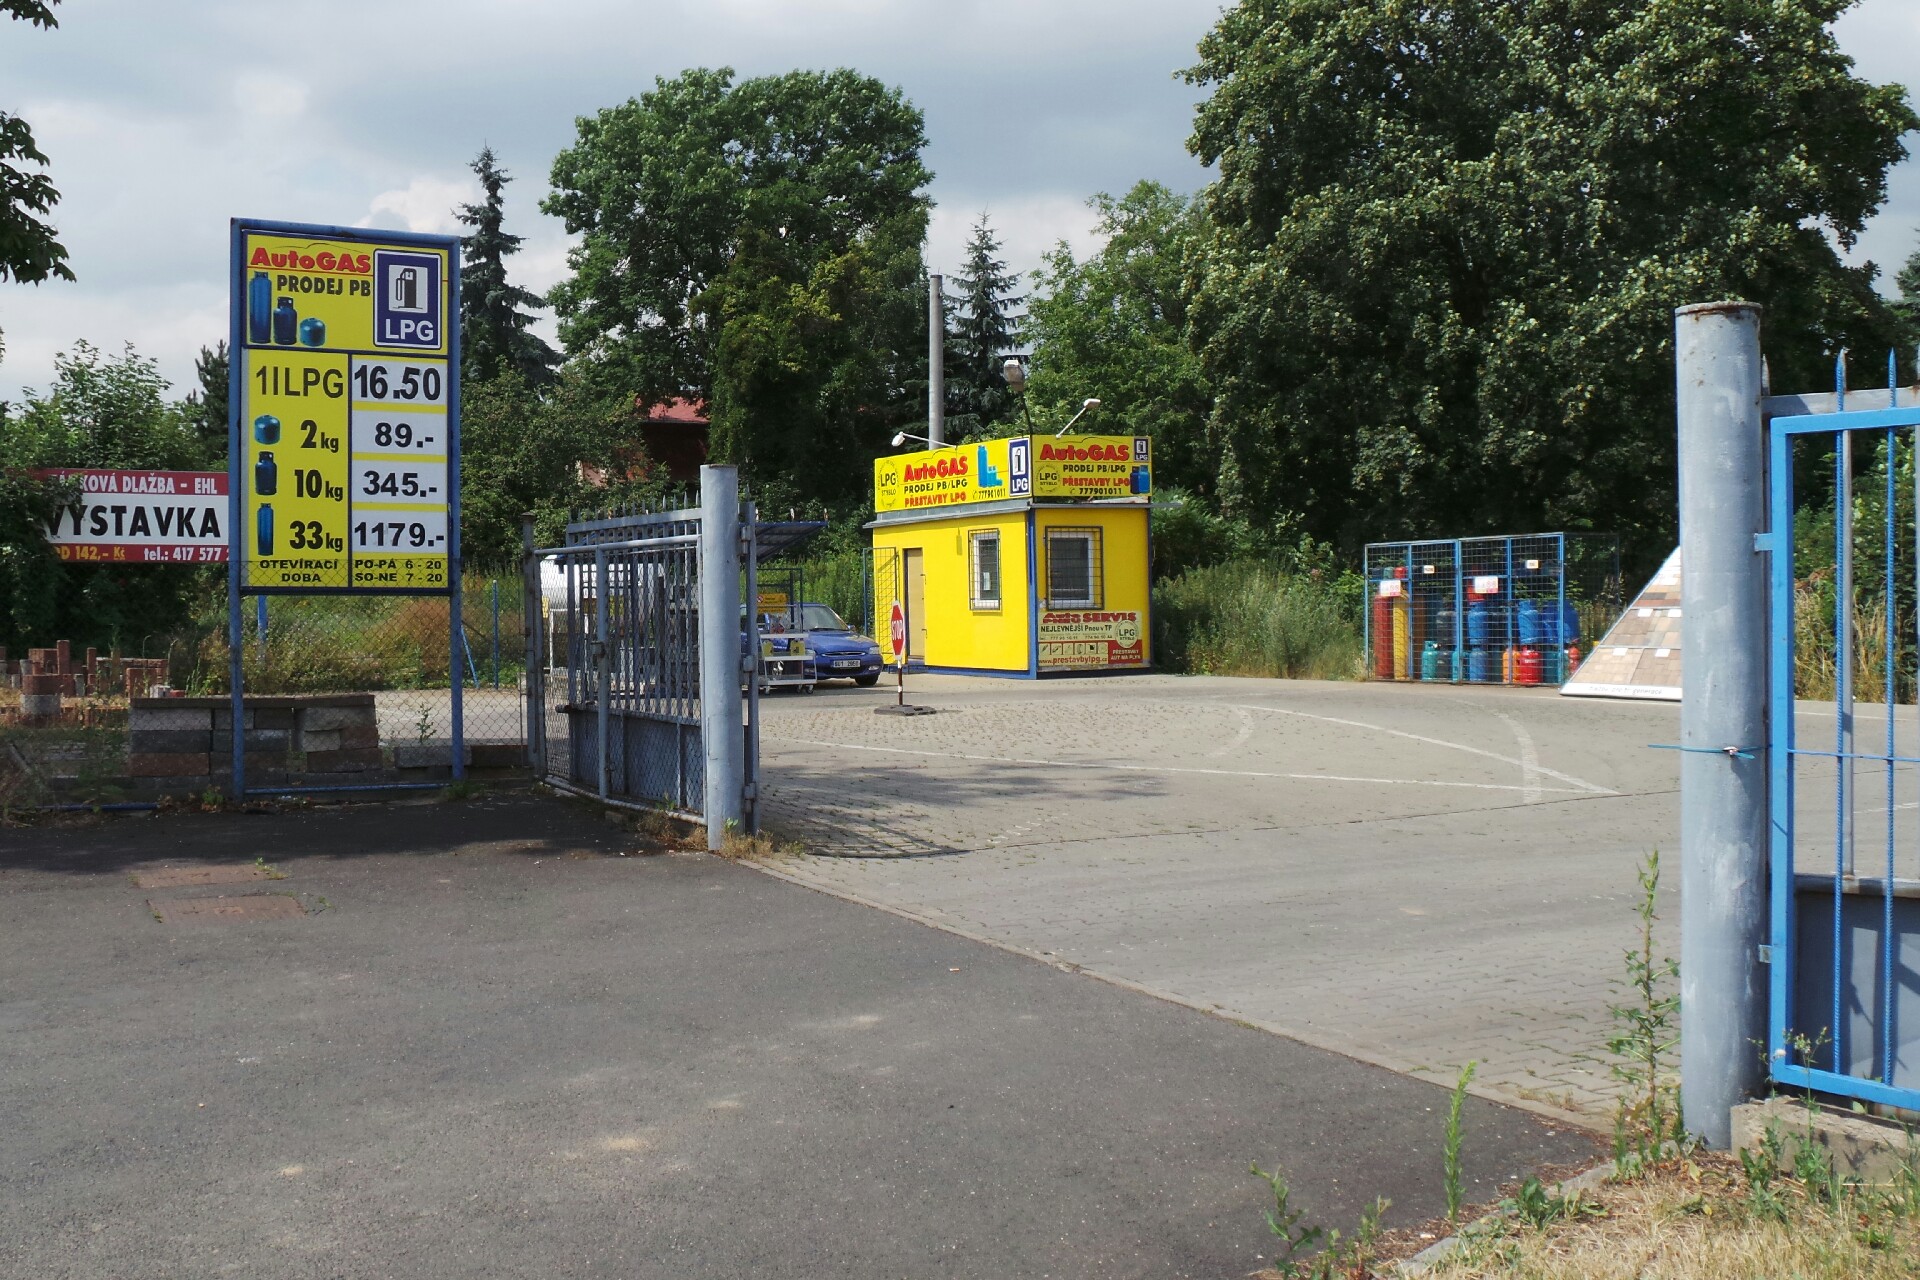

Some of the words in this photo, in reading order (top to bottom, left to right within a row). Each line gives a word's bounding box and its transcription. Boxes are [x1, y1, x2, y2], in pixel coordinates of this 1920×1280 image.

[250, 247, 371, 273] AutoGAS
[277, 275, 343, 296] PRODEJ
[350, 279, 371, 297] PB
[386, 319, 434, 341] LPG
[354, 365, 441, 400] 16.50
[375, 422, 434, 448] 89.-
[1040, 443, 1130, 461] AutoGAS
[903, 455, 969, 483] AutoGAS
[1039, 472, 1058, 481] LPG
[1063, 464, 1094, 473] PRODEJ
[1097, 464, 1127, 473] PB/LPG
[122, 472, 175, 494] DLAŽBA
[195, 477, 218, 494] EHL
[362, 470, 437, 497] 345.-
[880, 472, 897, 487] LPG
[904, 481, 934, 495] PRODEJ
[937, 478, 968, 491] PB/LPG
[1012, 478, 1029, 492] LPG
[1079, 487, 1122, 495] 777901011
[354, 522, 445, 547] 1179.-
[144, 547, 169, 561] tel.:
[173, 547, 192, 561] 417
[199, 547, 221, 561] 577
[405, 560, 413, 569] 6
[426, 561, 442, 570] 20
[282, 573, 321, 582] DOBA
[354, 573, 397, 582] SO-NE
[406, 573, 414, 582] 7
[427, 573, 443, 582] 20
[892, 619, 904, 640] STOP
[1118, 629, 1135, 637] LPG
